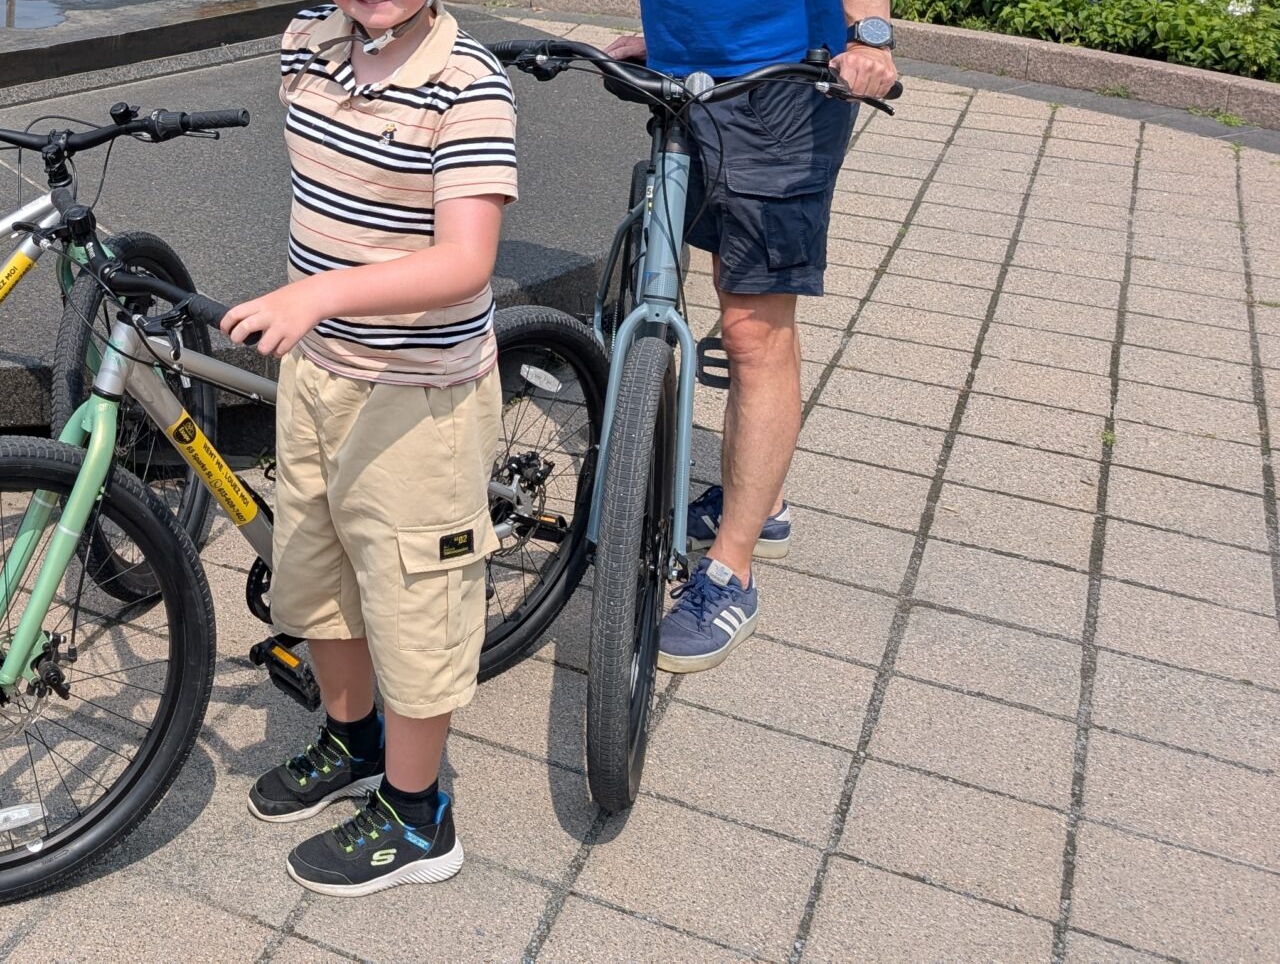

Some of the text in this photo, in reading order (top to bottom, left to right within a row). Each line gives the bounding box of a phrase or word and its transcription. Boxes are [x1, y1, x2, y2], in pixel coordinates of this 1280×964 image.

[192, 452, 207, 472] Sparks
[203, 443, 217, 461] RENT
[216, 460, 224, 472] ME
[224, 472, 241, 494] LOUEZ
